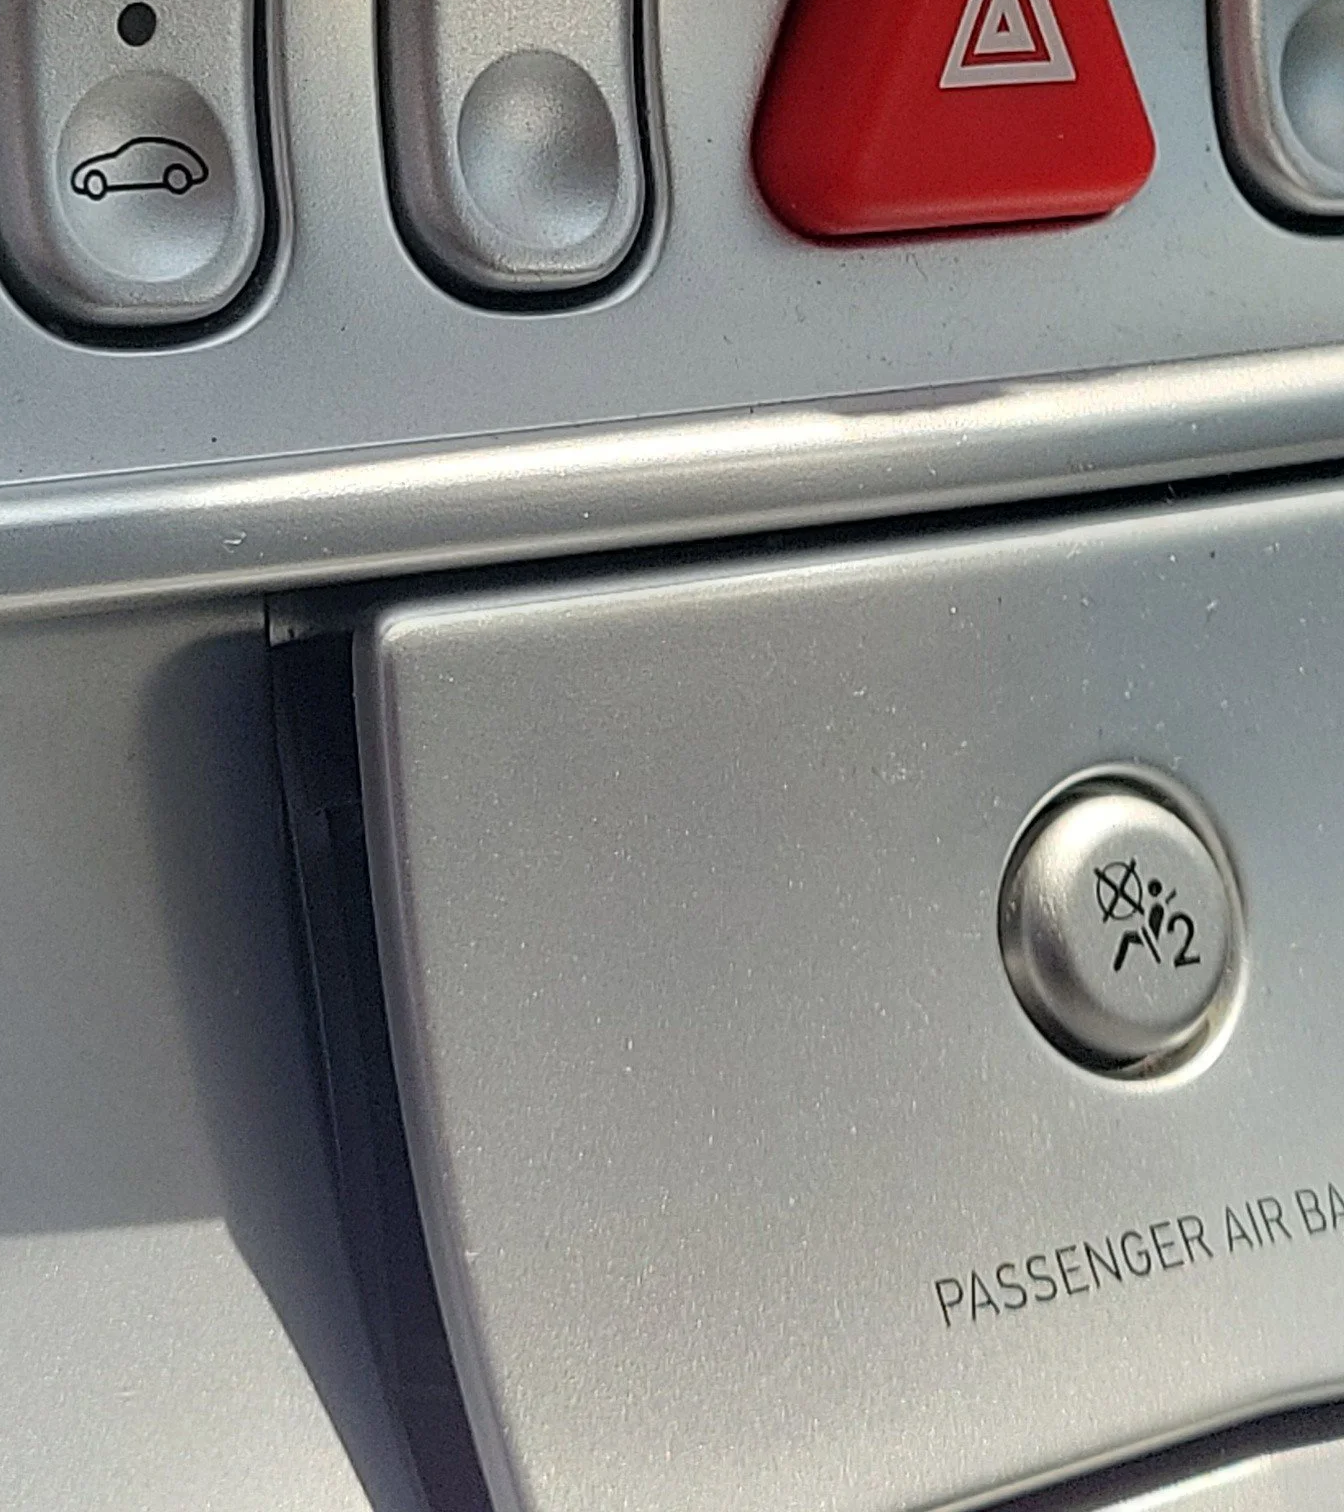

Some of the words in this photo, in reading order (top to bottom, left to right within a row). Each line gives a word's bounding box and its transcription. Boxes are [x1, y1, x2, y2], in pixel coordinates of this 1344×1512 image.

[1166, 914, 1201, 968] 2
[934, 1213, 1214, 1328] PASSENGER
[1223, 1195, 1292, 1253] AIR
